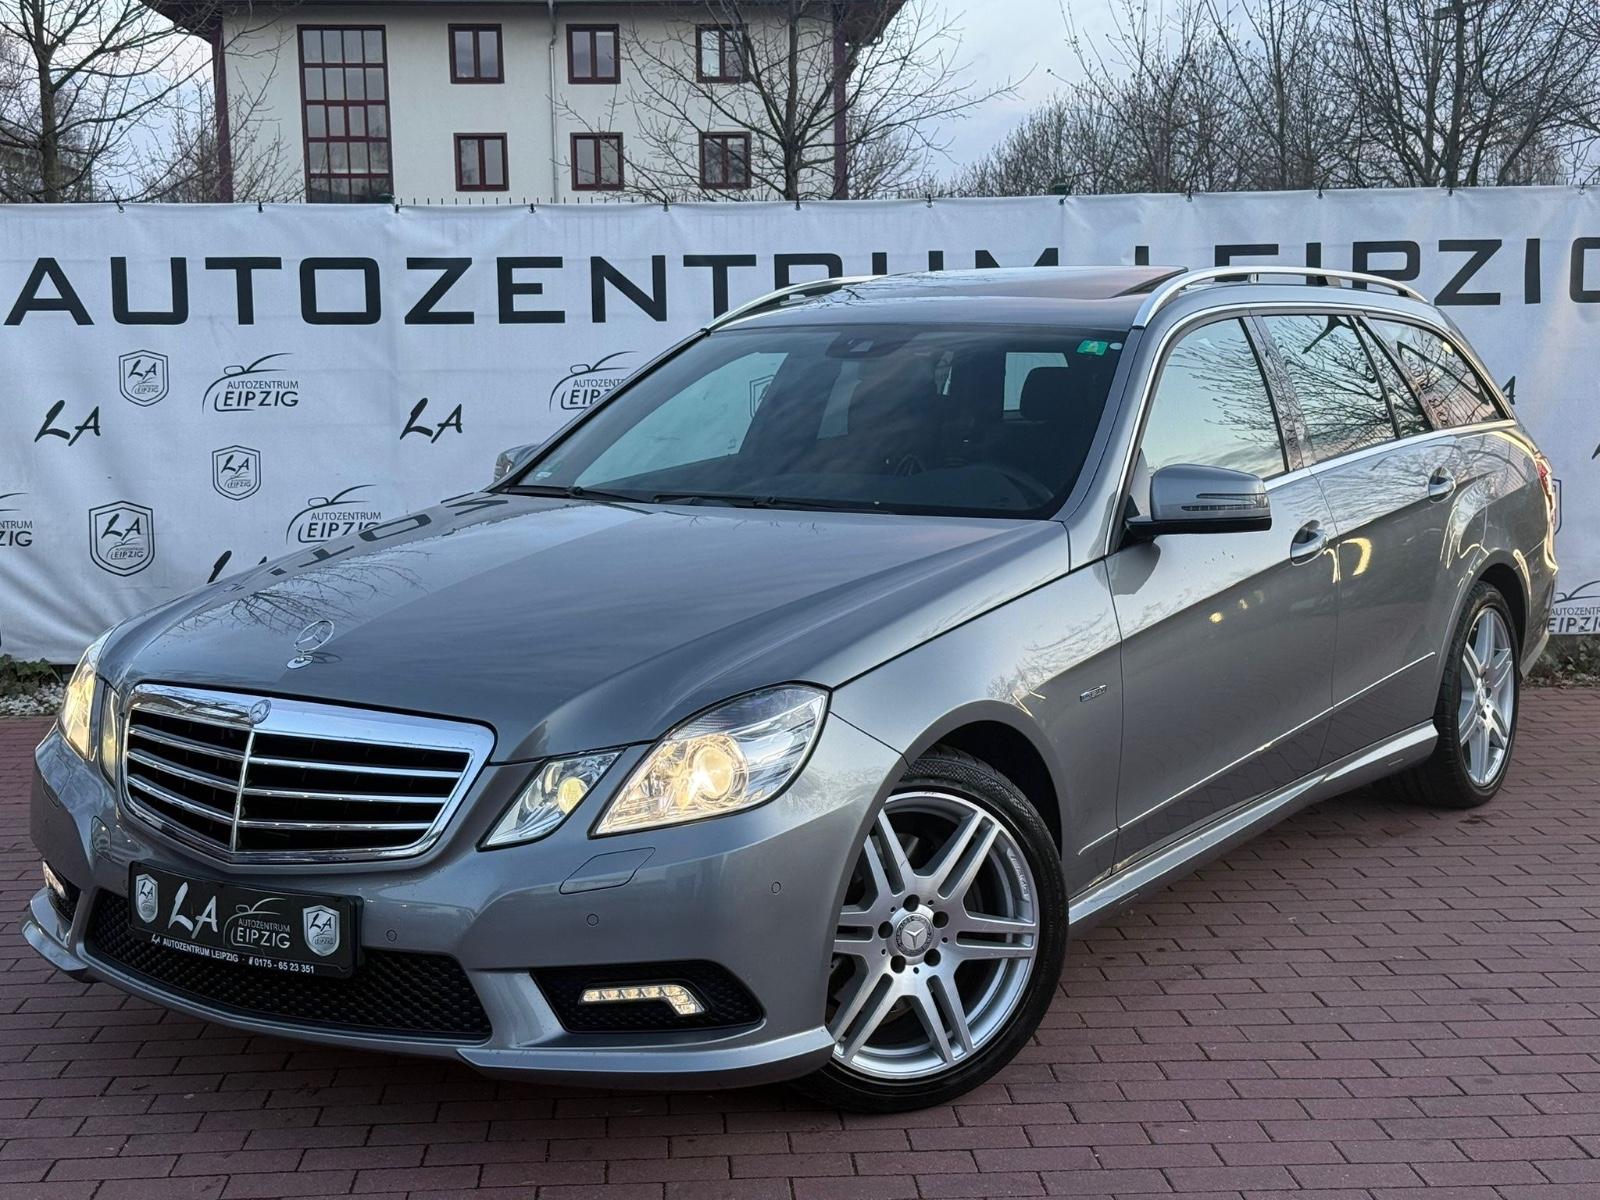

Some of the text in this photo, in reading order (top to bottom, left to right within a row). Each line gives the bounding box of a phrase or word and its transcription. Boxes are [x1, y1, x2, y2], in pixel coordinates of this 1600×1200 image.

[227, 381, 299, 390] AUTOZENTRUM
[34, 400, 101, 447] LA
[400, 397, 463, 443] LA
[311, 511, 382, 521] AUTOZENTRUM
[167, 881, 219, 940] LA
[238, 918, 291, 934] AUTOZENTRUM
[162, 938, 210, 957] AUTOZENTRUM
[211, 950, 239, 963] LEIPZIG
[289, 963, 299, 972] 23
[301, 965, 315, 974] 351
